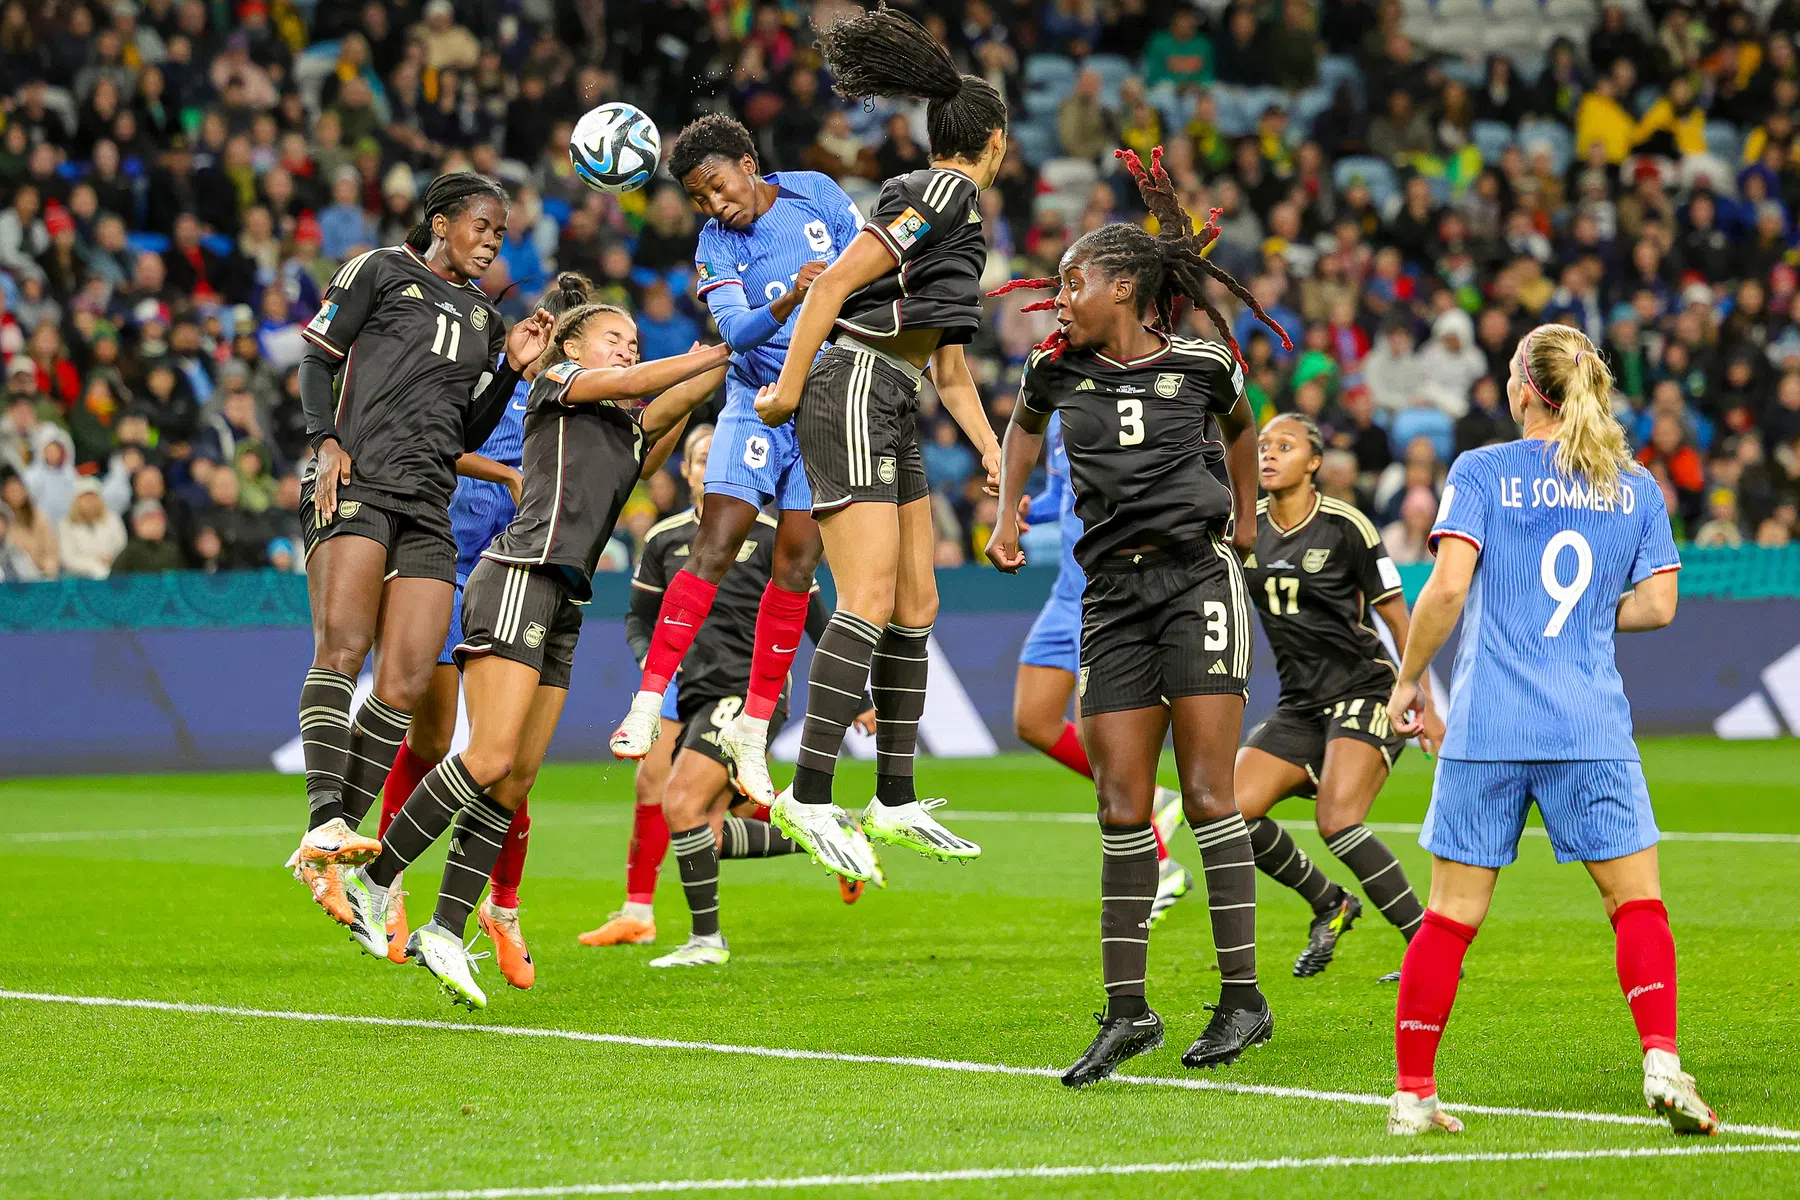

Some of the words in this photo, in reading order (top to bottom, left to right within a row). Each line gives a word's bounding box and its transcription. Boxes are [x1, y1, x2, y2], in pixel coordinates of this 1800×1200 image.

[431, 313, 460, 362] 11
[1117, 399, 1145, 446] 3
[1500, 477, 1523, 508] LE
[1264, 577, 1300, 615] 17
[1541, 529, 1593, 638] 9
[1203, 601, 1228, 651] 3
[710, 695, 742, 729] 8
